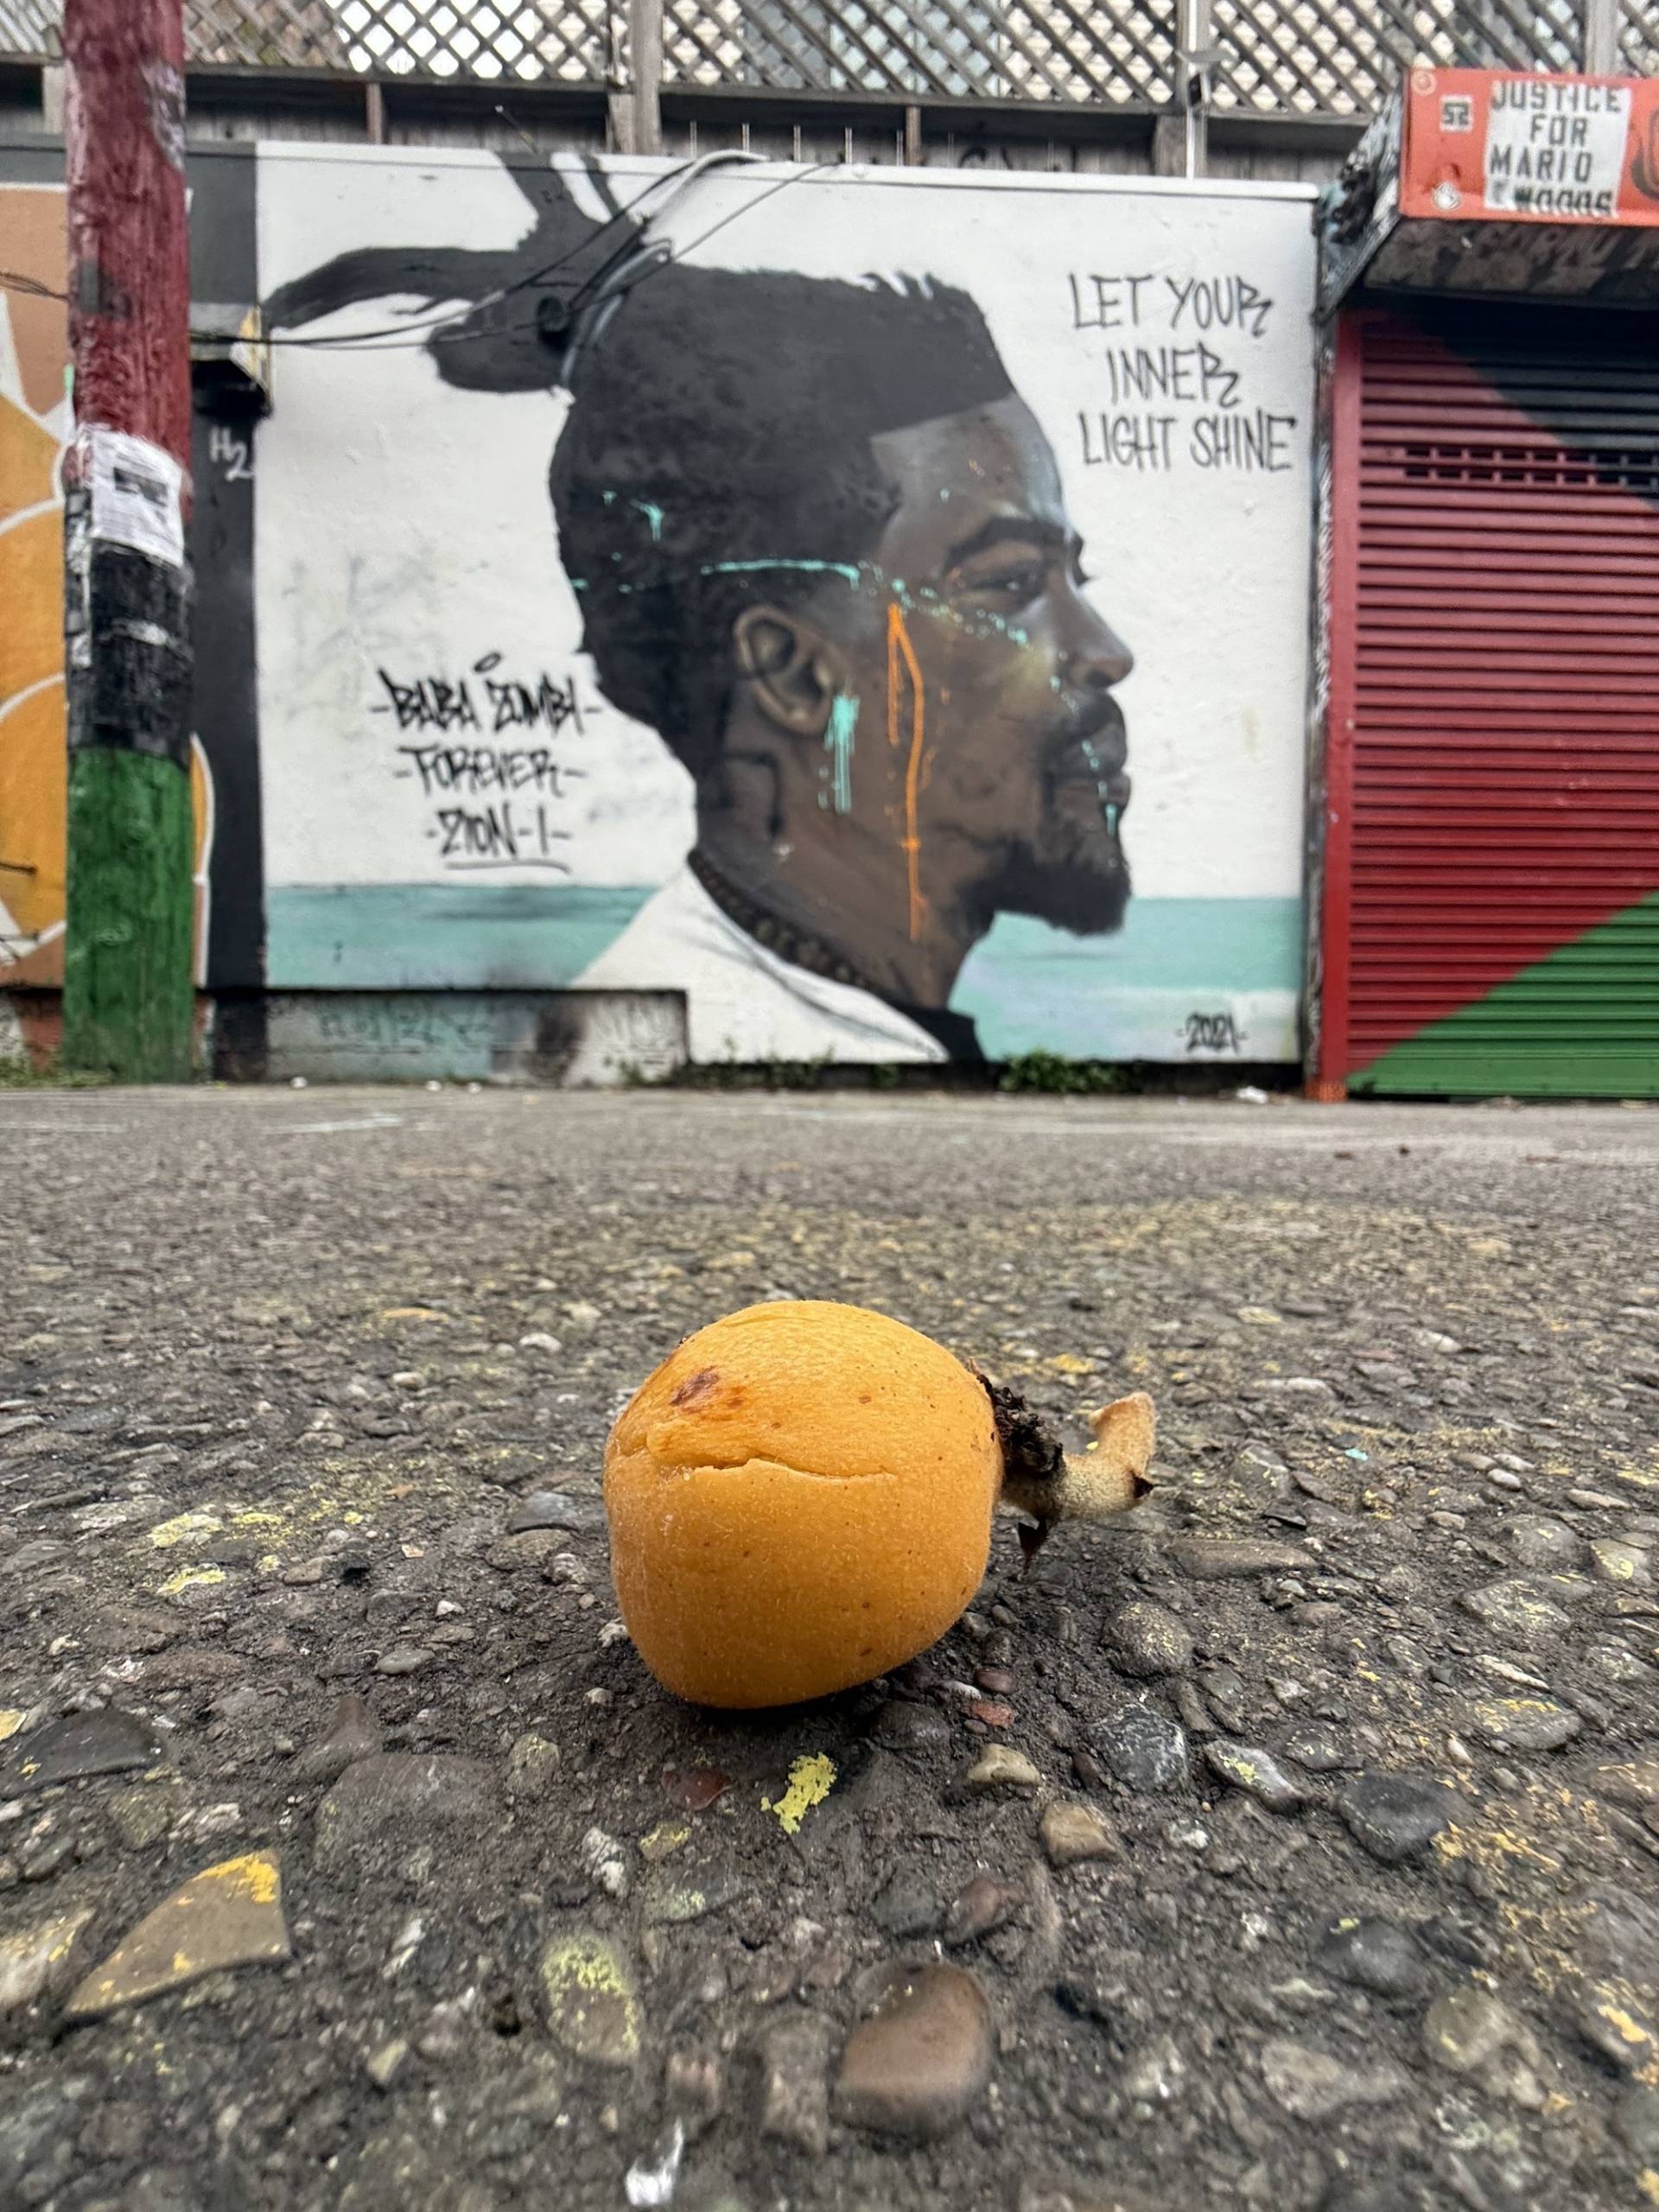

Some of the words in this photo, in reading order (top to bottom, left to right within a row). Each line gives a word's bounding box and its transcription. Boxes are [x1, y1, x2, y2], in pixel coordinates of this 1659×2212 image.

[1491, 80, 1621, 113] JUSTICE
[1530, 113, 1588, 147] FOR
[1491, 144, 1592, 183] MARIO
[1068, 273, 1154, 330] LET
[1164, 274, 1274, 338] YOUR
[1106, 339, 1241, 408] INNER
[1077, 410, 1177, 472] LIGHT
[1190, 406, 1298, 473] SHINE
